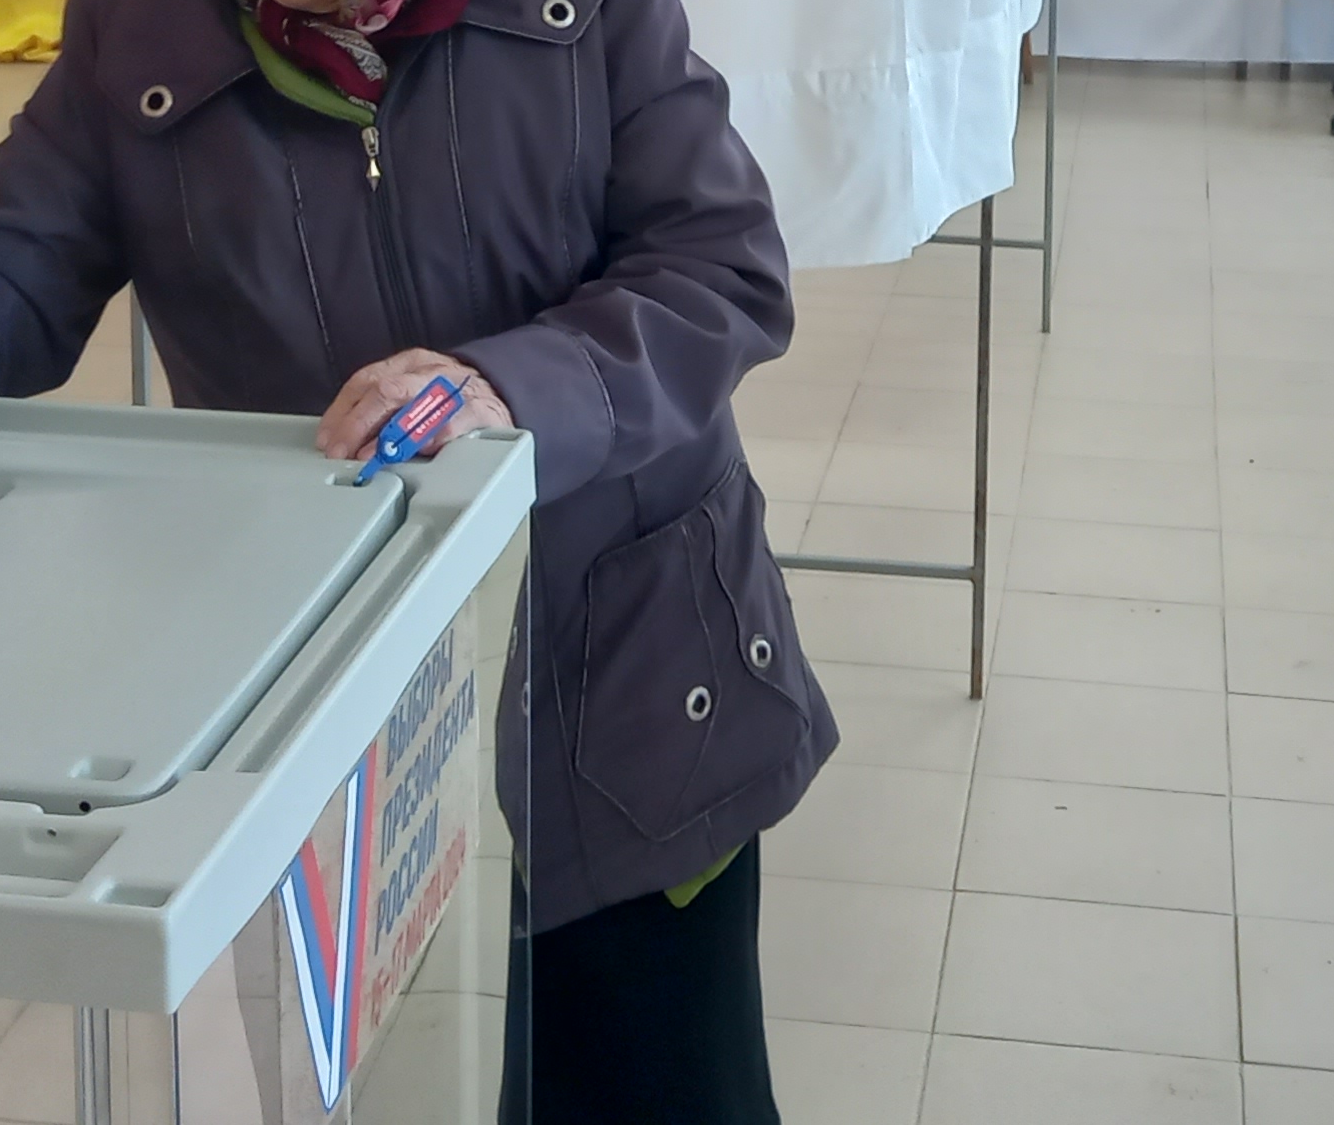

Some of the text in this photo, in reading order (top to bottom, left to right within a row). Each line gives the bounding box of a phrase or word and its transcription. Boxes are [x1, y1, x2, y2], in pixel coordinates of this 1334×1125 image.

[380, 668, 475, 868] ПРЕЗИДЕНТА
[386, 628, 453, 778] ВЫБОРЫ
[374, 798, 438, 956] РОССИИ
